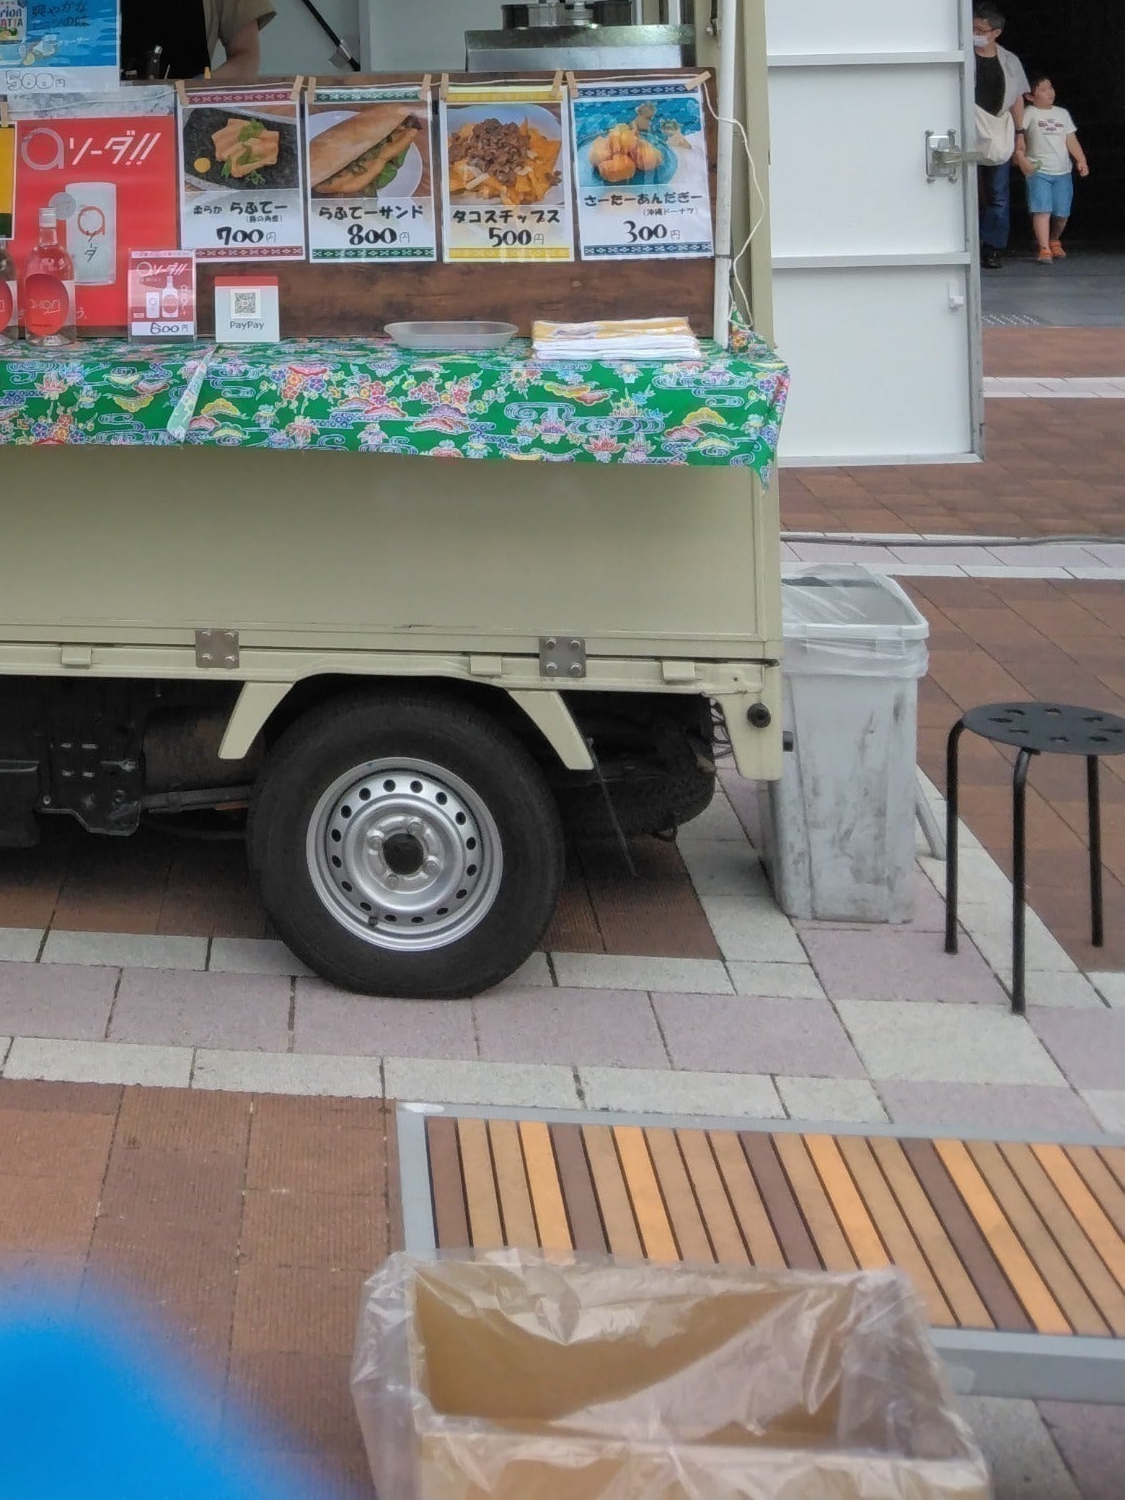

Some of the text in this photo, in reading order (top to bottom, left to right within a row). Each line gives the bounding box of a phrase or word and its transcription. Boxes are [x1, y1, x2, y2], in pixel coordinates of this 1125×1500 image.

[5, 69, 66, 91] 500円
[584, 191, 703, 207] さーたーあんだぎー
[193, 201, 288, 215] 柔らか らふてー
[318, 204, 424, 221] らふてーサンド
[452, 209, 561, 224] タコスチップス
[216, 226, 277, 245] 700円
[347, 223, 411, 246] 800円
[488, 226, 545, 248] 500円
[623, 220, 681, 243] 300円
[150, 322, 189, 335] 600円
[229, 320, 265, 331] PayPay
